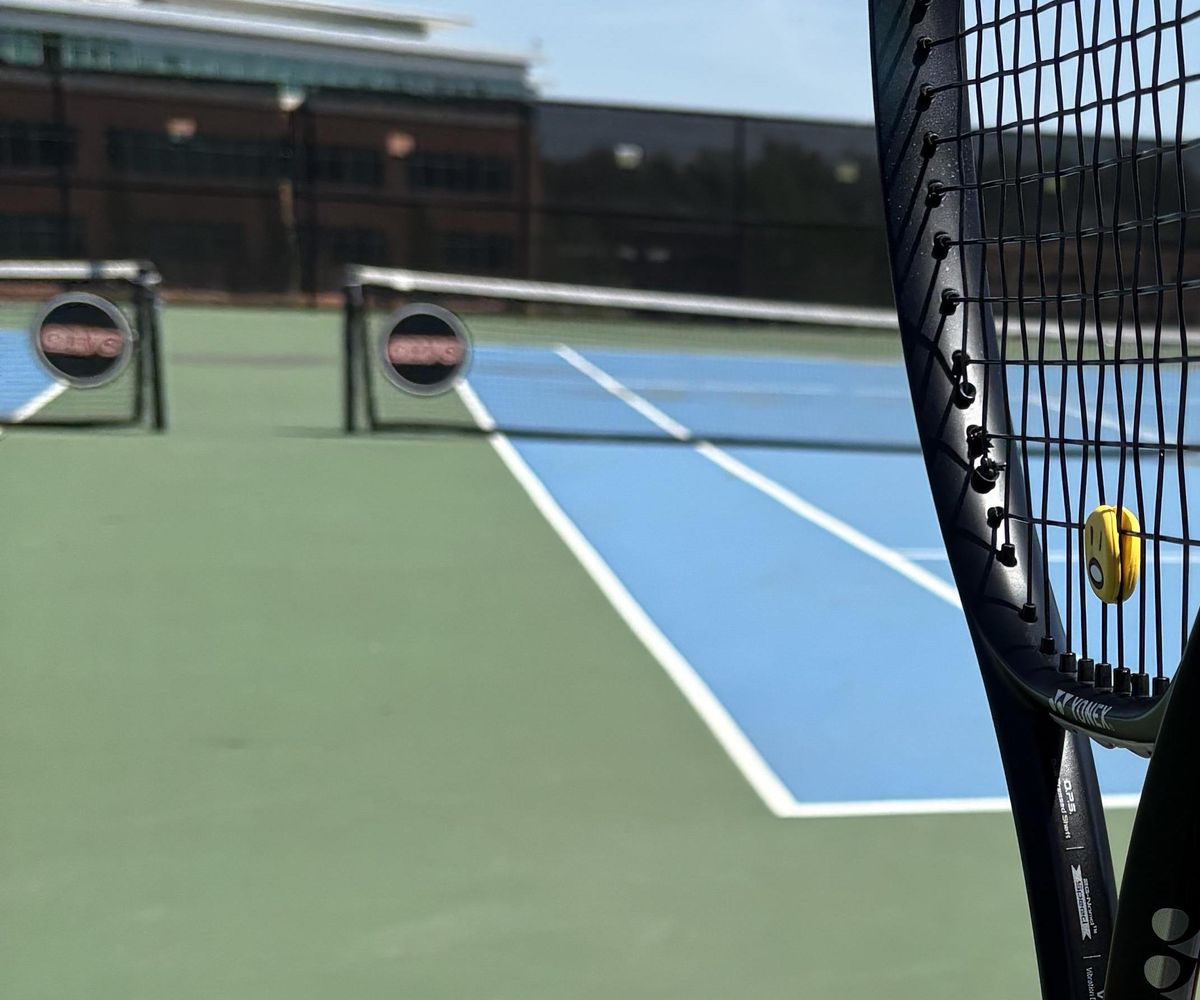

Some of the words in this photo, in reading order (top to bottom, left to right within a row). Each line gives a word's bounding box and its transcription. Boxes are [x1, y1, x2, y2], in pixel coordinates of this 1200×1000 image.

[1071, 696, 1112, 729] YONEX
[1061, 815, 1071, 839] Shaft
[1076, 880, 1088, 925] Speed
[1086, 967, 1095, 997] Vibration
